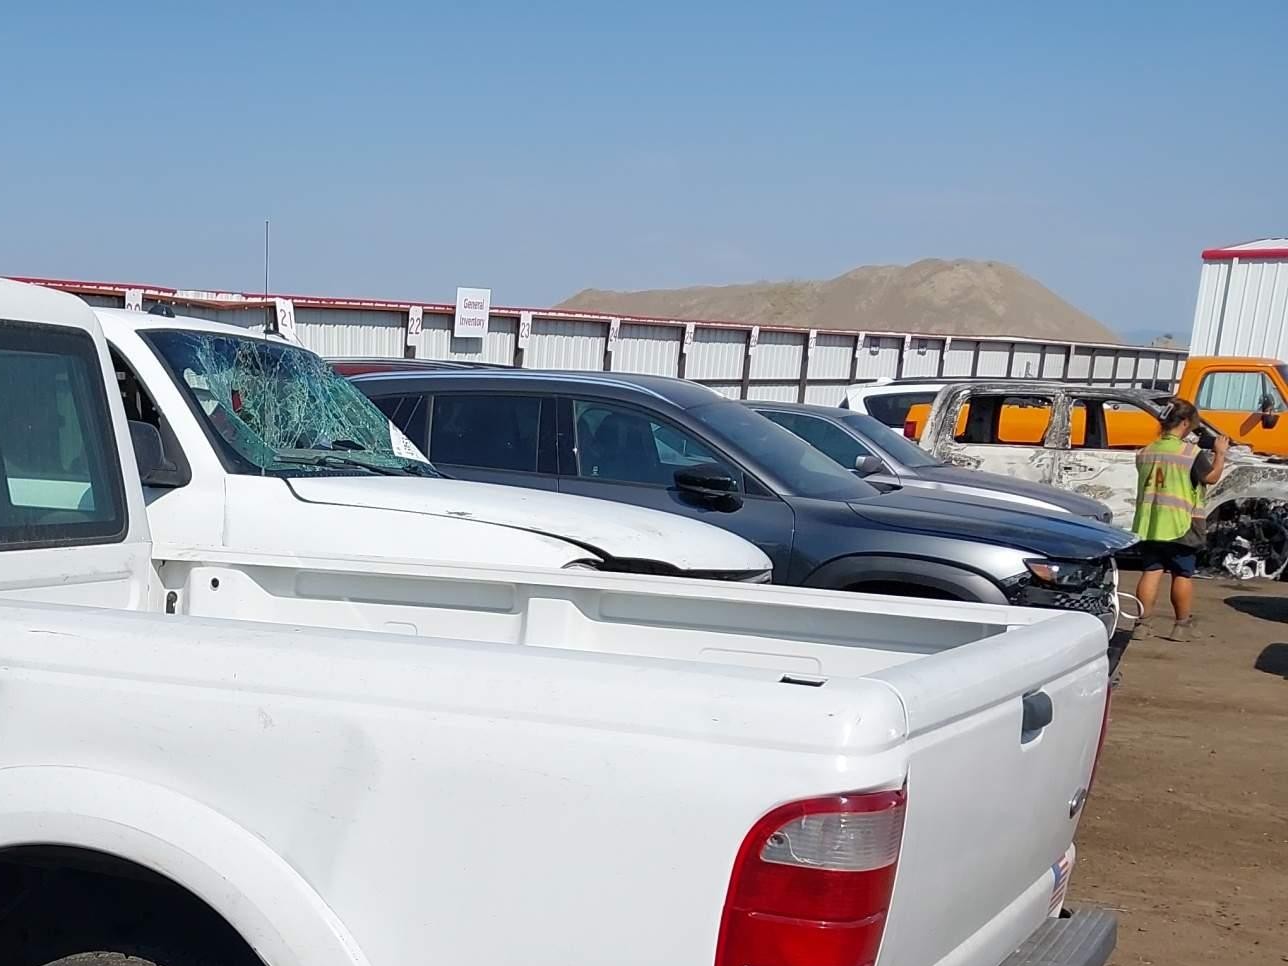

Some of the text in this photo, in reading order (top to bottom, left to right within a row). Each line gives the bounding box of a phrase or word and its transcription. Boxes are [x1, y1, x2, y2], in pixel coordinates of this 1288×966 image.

[463, 298, 485, 310] General
[279, 308, 293, 329] 21
[408, 317, 421, 335] 22
[459, 315, 486, 328] Inventory
[520, 322, 530, 339] 23
